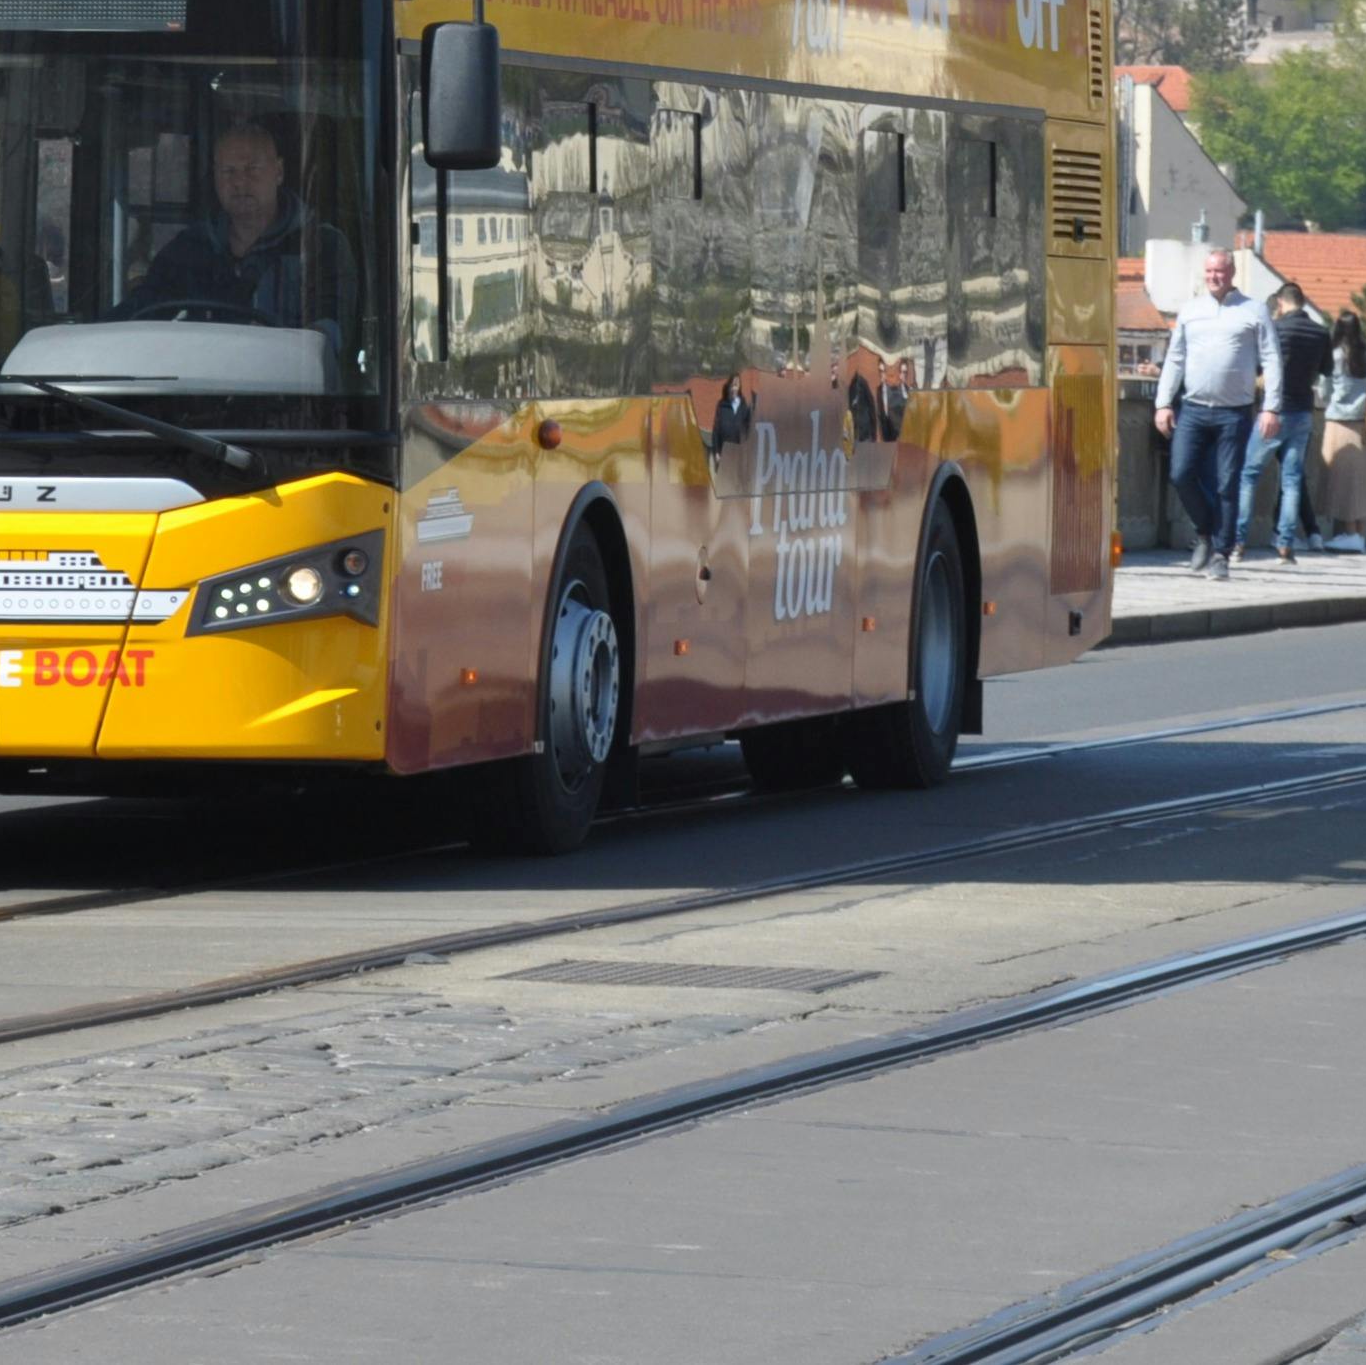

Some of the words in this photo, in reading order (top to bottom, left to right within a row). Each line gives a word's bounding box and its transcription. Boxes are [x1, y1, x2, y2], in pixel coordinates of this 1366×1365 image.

[749, 409, 847, 535] Praha
[774, 520, 843, 620] tour
[34, 649, 155, 687] BOAT
